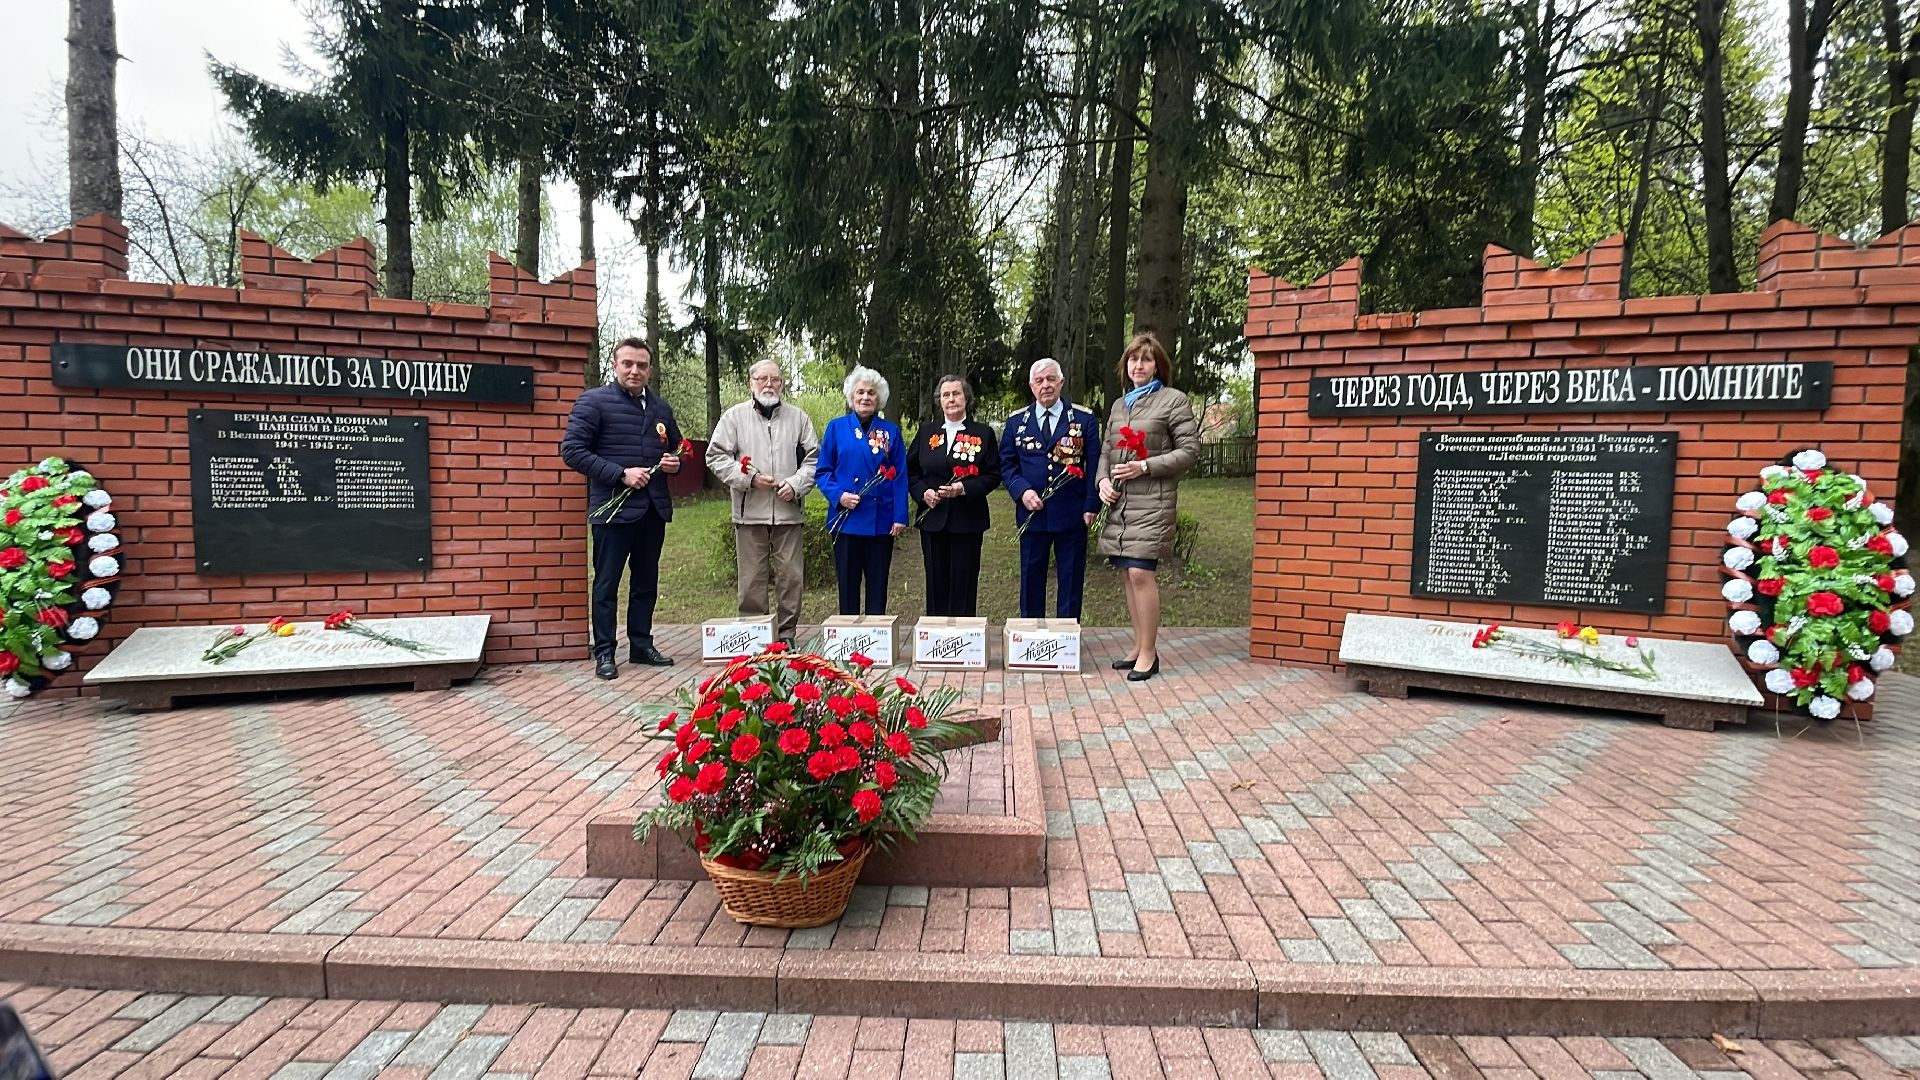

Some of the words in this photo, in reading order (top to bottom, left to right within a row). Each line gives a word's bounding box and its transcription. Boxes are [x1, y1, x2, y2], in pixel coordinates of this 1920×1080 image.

[126, 347, 182, 381] ОНИ
[188, 350, 342, 387] СРАЖАЛИСЬ
[347, 357, 376, 388] ЗА
[381, 359, 472, 397] РОДИНУ
[1330, 374, 1401, 408] ЧЕРЕЗ
[1406, 373, 1474, 412] ГОДА,
[1480, 370, 1560, 404] ЧЕРЕЗ
[1566, 367, 1636, 403] ВЕКА
[1642, 386, 1652, 394] -
[1656, 363, 1803, 402] ПОМНИТЕ
[234, 414, 287, 423] ВЕЧНАЯ
[291, 415, 333, 424] СЛАВА
[336, 416, 388, 426] ВОИНАМ
[259, 423, 318, 432] ПАВШИМ
[322, 424, 330, 432] В
[333, 424, 366, 433] БОЯХ
[230, 431, 280, 440] Великой
[284, 432, 369, 442] Отечественной
[372, 434, 404, 443] войне
[1440, 434, 1484, 443] Воинам
[1488, 434, 1549, 444] погибшим
[1564, 436, 1594, 444] годы
[1598, 434, 1654, 444] Великой
[1435, 443, 1523, 452] Отечественной
[1526, 443, 1567, 452] войны
[1570, 444, 1596, 452] 1941
[1608, 444, 1636, 453] 1945
[1489, 452, 1544, 462] п.Лесной
[1547, 453, 1597, 463] городок
[1551, 470, 1614, 478] Лукьянов
[1549, 505, 1613, 513] Меркулов
[1549, 512, 1603, 520] Морозов
[1429, 560, 1476, 568] Киселев
[1428, 566, 1485, 575] Карманов
[1428, 573, 1485, 582] Карманов
[1545, 573, 1590, 582] Хренов
[1544, 580, 1604, 589] Чесноков
[1427, 585, 1470, 594] Крюков
[1544, 587, 1586, 595] Фомин
